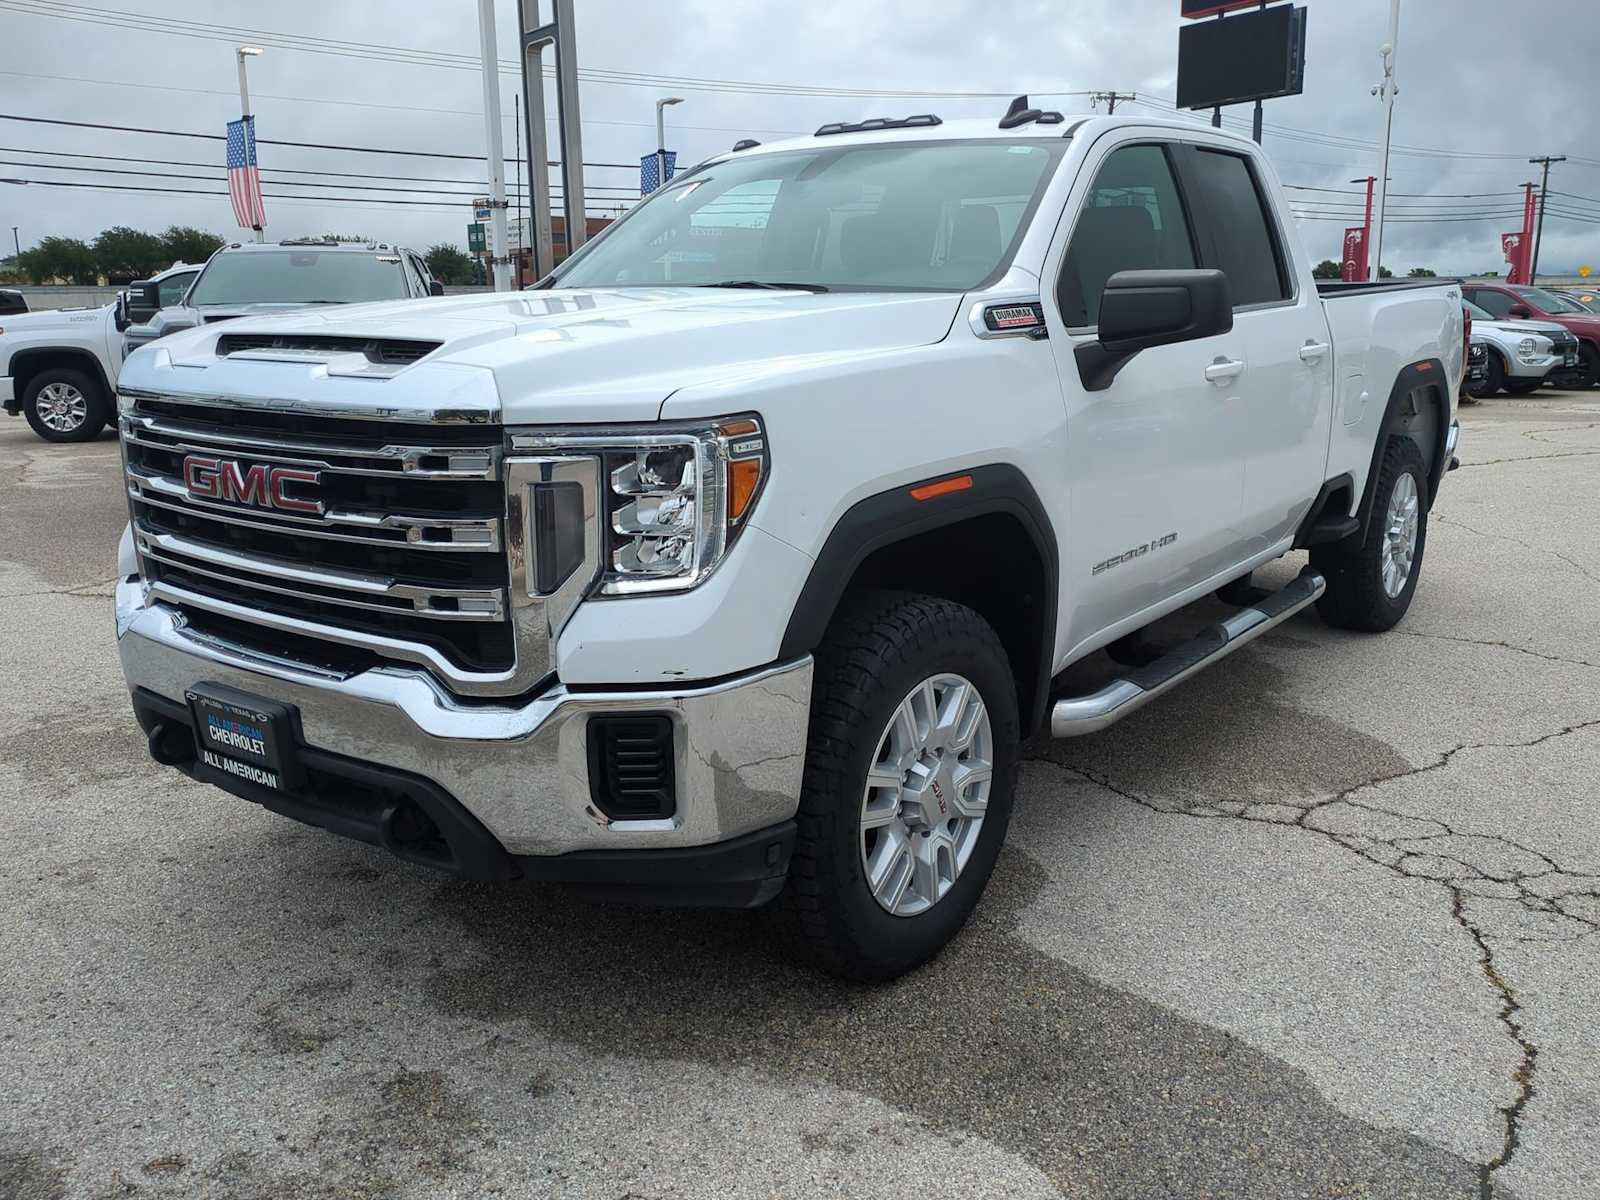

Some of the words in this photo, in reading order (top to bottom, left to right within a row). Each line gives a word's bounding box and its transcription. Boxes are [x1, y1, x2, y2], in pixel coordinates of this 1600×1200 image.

[995, 308, 1033, 320] DURAMAX
[183, 455, 326, 515] GMC
[1151, 532, 1178, 551] HD
[208, 712, 221, 728] ALL
[222, 719, 264, 740] AMERICAN
[209, 725, 266, 756] CHEVROLET
[204, 751, 222, 769] ALL
[223, 757, 278, 788] AMERICAN
